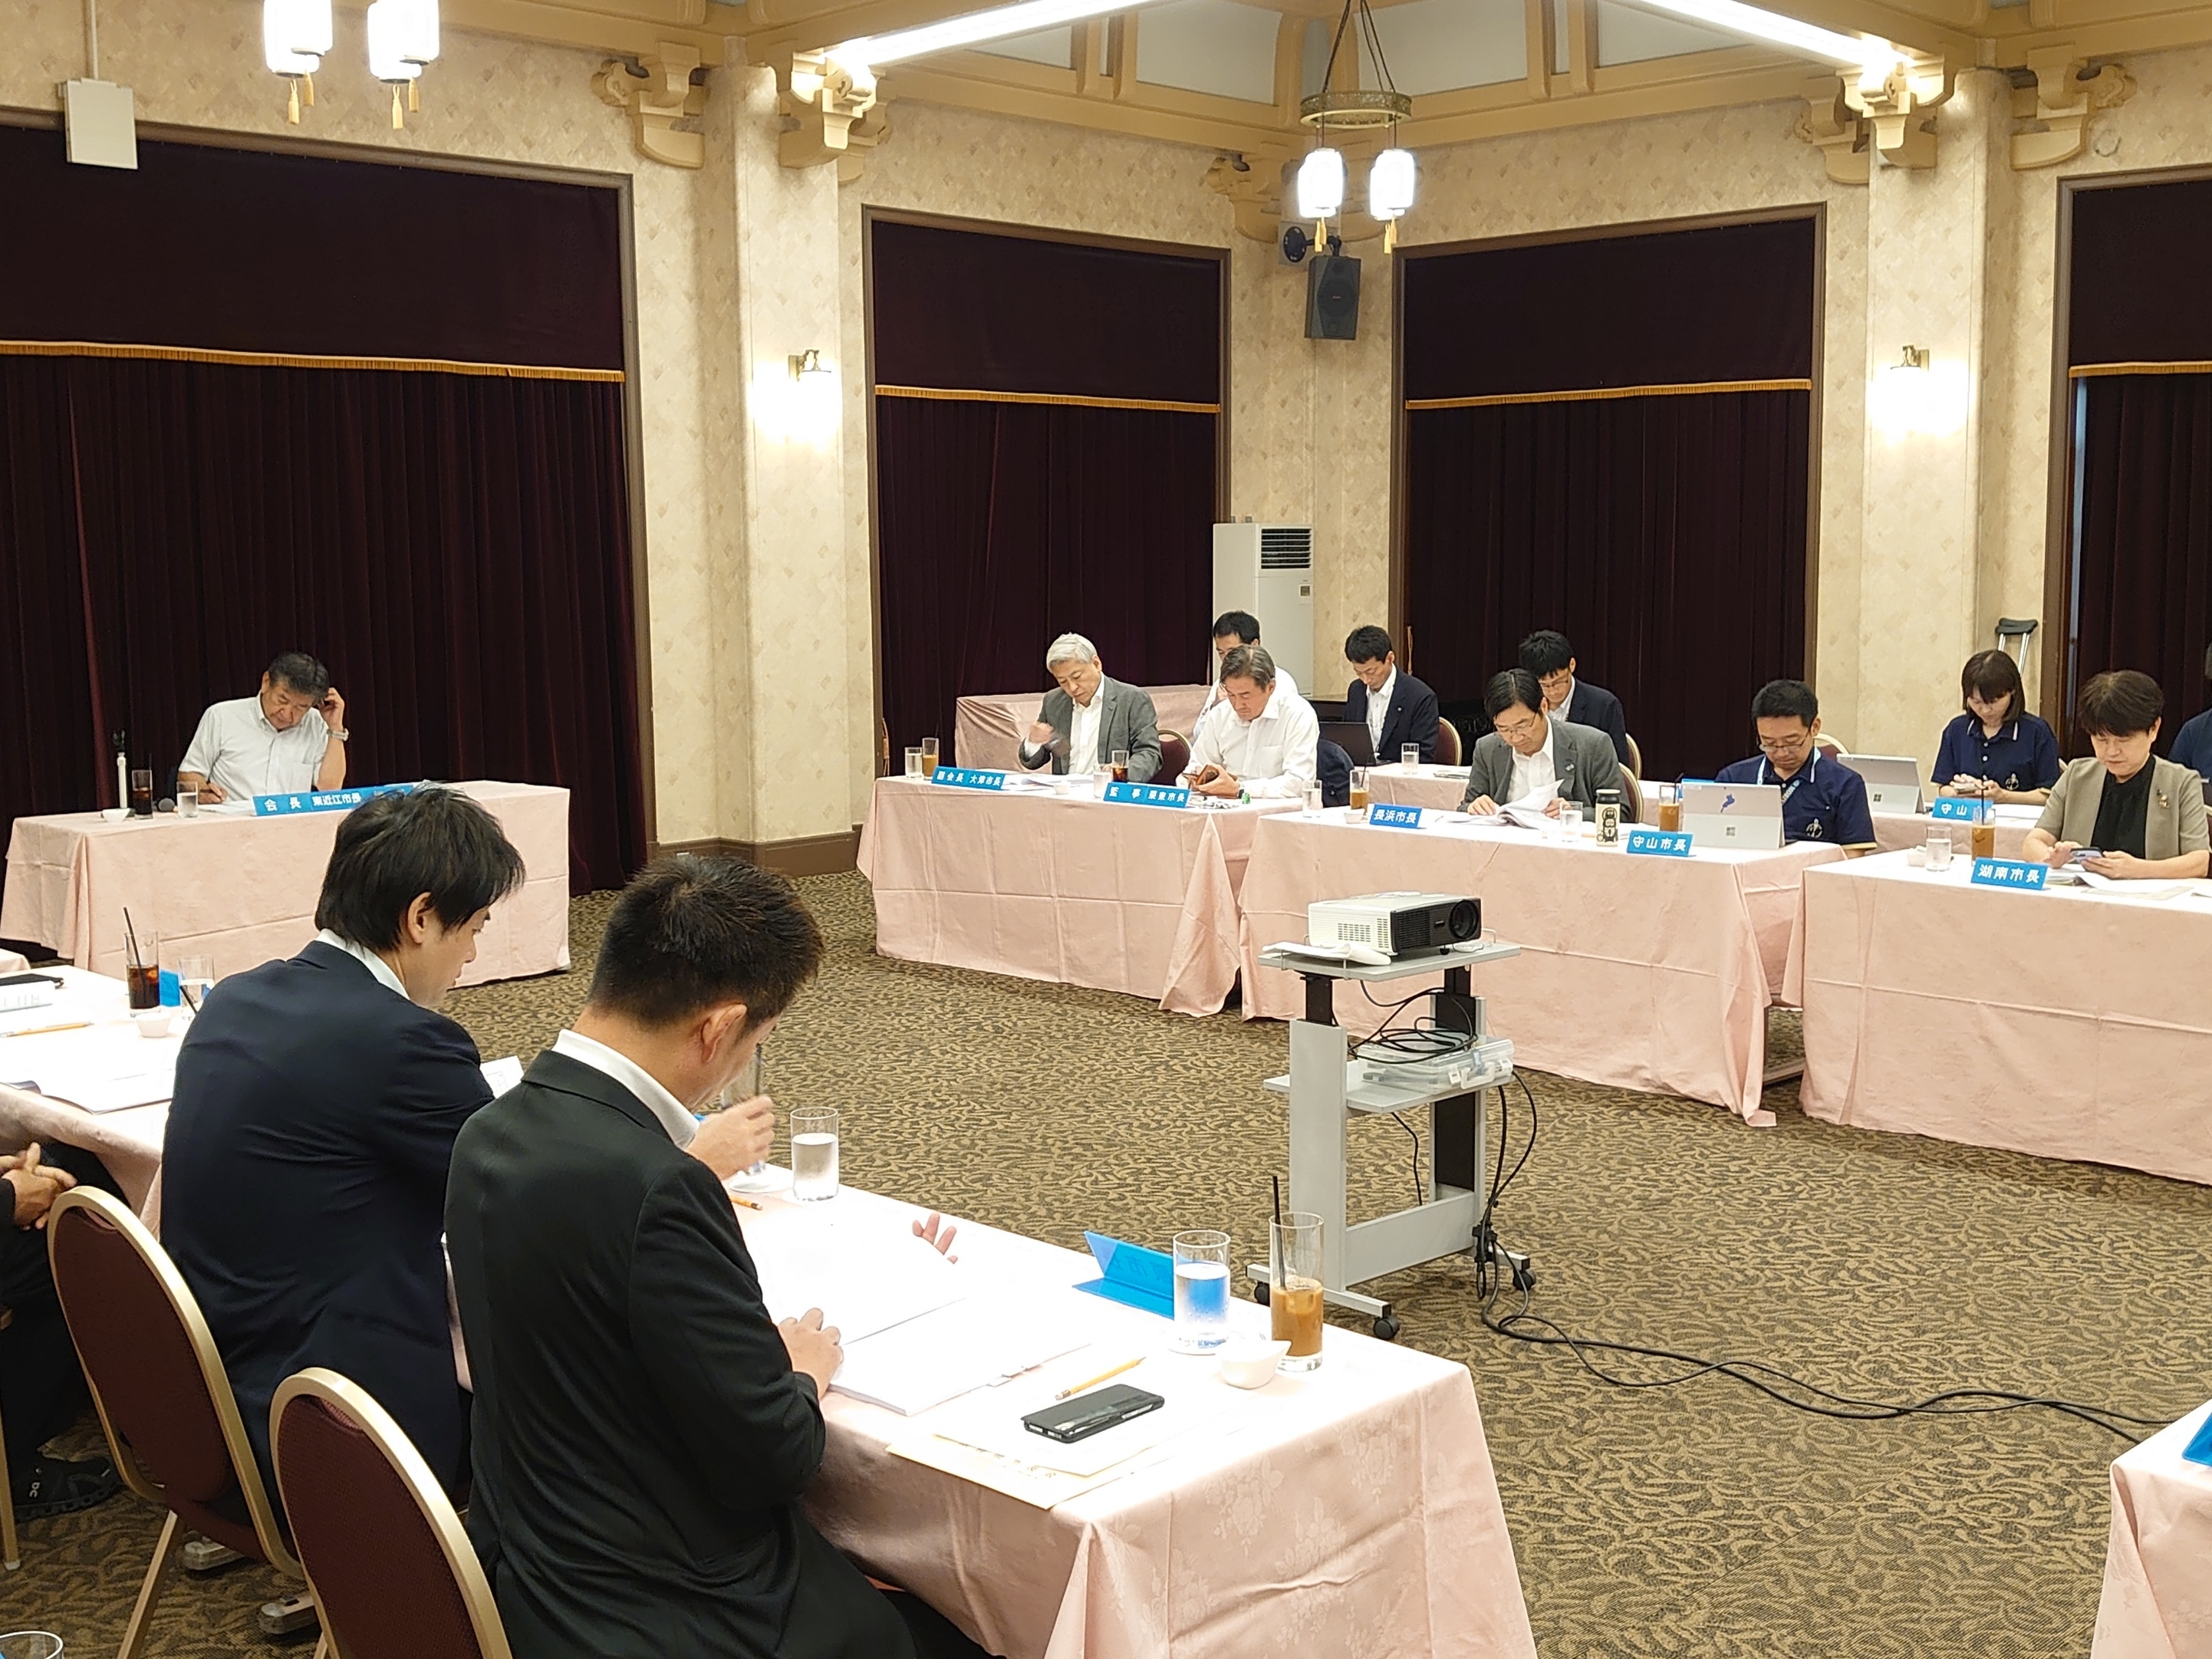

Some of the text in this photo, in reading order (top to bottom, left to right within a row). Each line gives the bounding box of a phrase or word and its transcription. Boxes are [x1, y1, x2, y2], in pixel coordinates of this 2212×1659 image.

[969, 774, 1002, 787] 大津市長
[312, 792, 362, 807] 東近江市長
[1373, 808, 1417, 824] 長浜市長
[1632, 834, 1687, 852] 守山市長
[1977, 864, 2040, 884] 湖南市長
